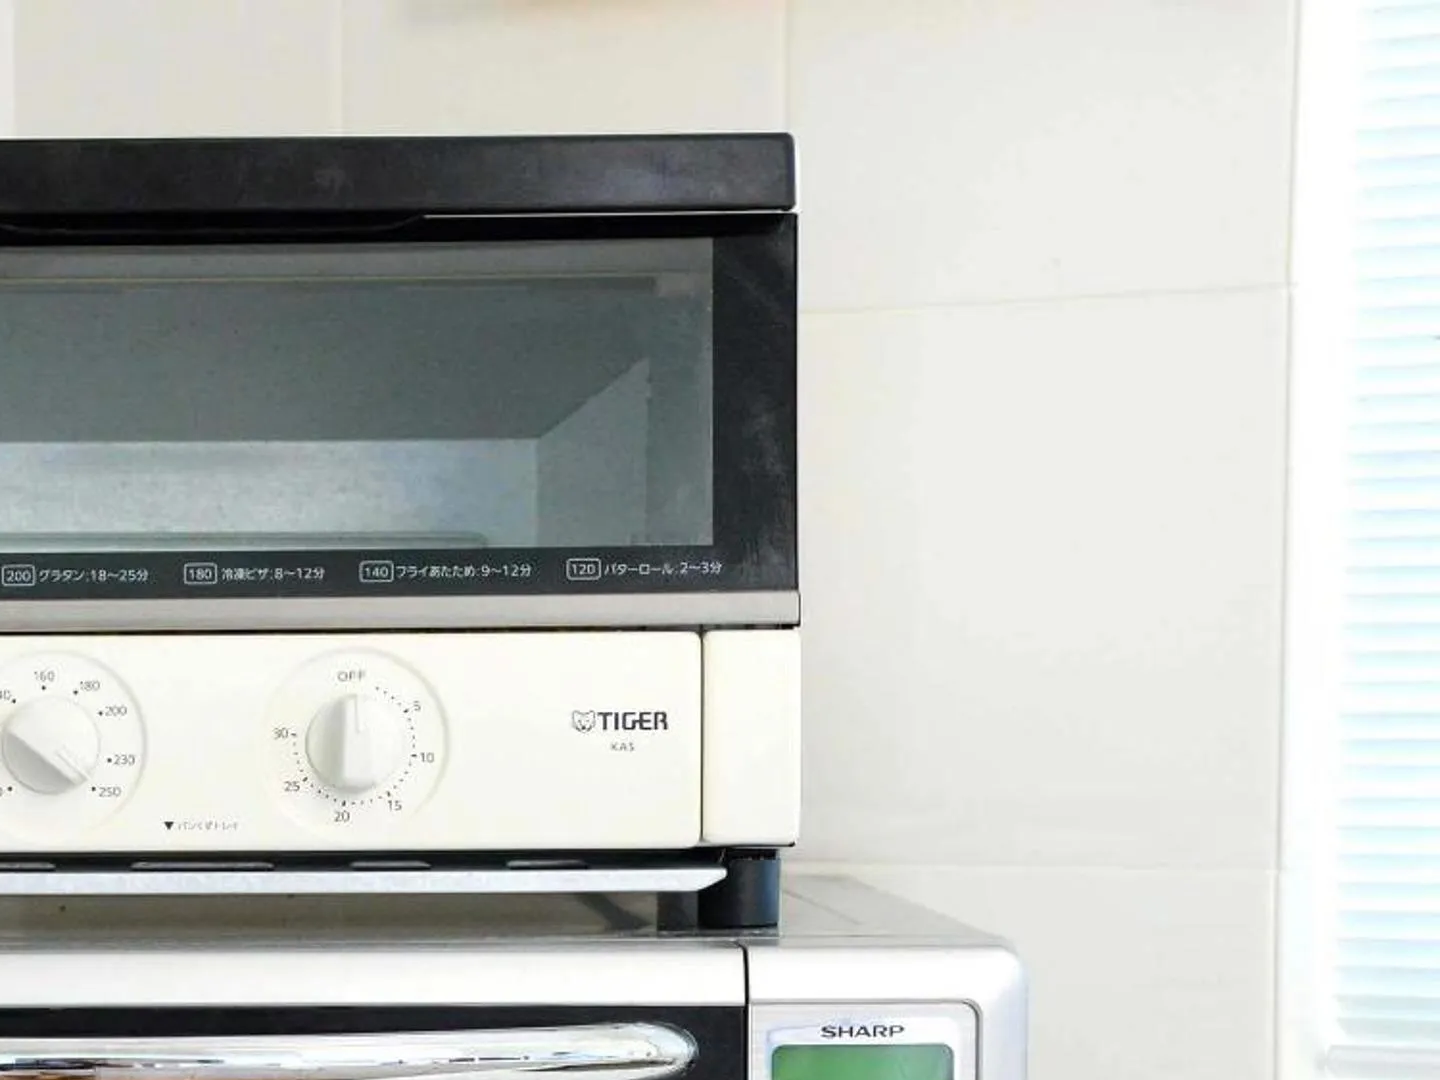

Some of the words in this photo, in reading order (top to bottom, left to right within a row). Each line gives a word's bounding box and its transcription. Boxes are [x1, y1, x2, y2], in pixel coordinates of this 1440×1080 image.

[188, 567, 213, 581] 180
[363, 565, 390, 579] 140
[571, 562, 597, 576] 120
[5, 569, 32, 583] 200
[34, 671, 55, 682] 160
[337, 671, 366, 682] OFF
[80, 681, 100, 691] 180
[105, 706, 127, 716] 200
[414, 701, 421, 712] 5
[597, 711, 668, 731] TIGER
[273, 728, 289, 739] 30
[611, 742, 635, 752] KAS
[114, 755, 135, 765] 230
[421, 752, 435, 763] 10
[99, 787, 121, 797] 250
[285, 782, 301, 793] 25
[389, 801, 402, 812] 15
[334, 812, 350, 823] 20
[821, 1025, 905, 1038] SHARP
